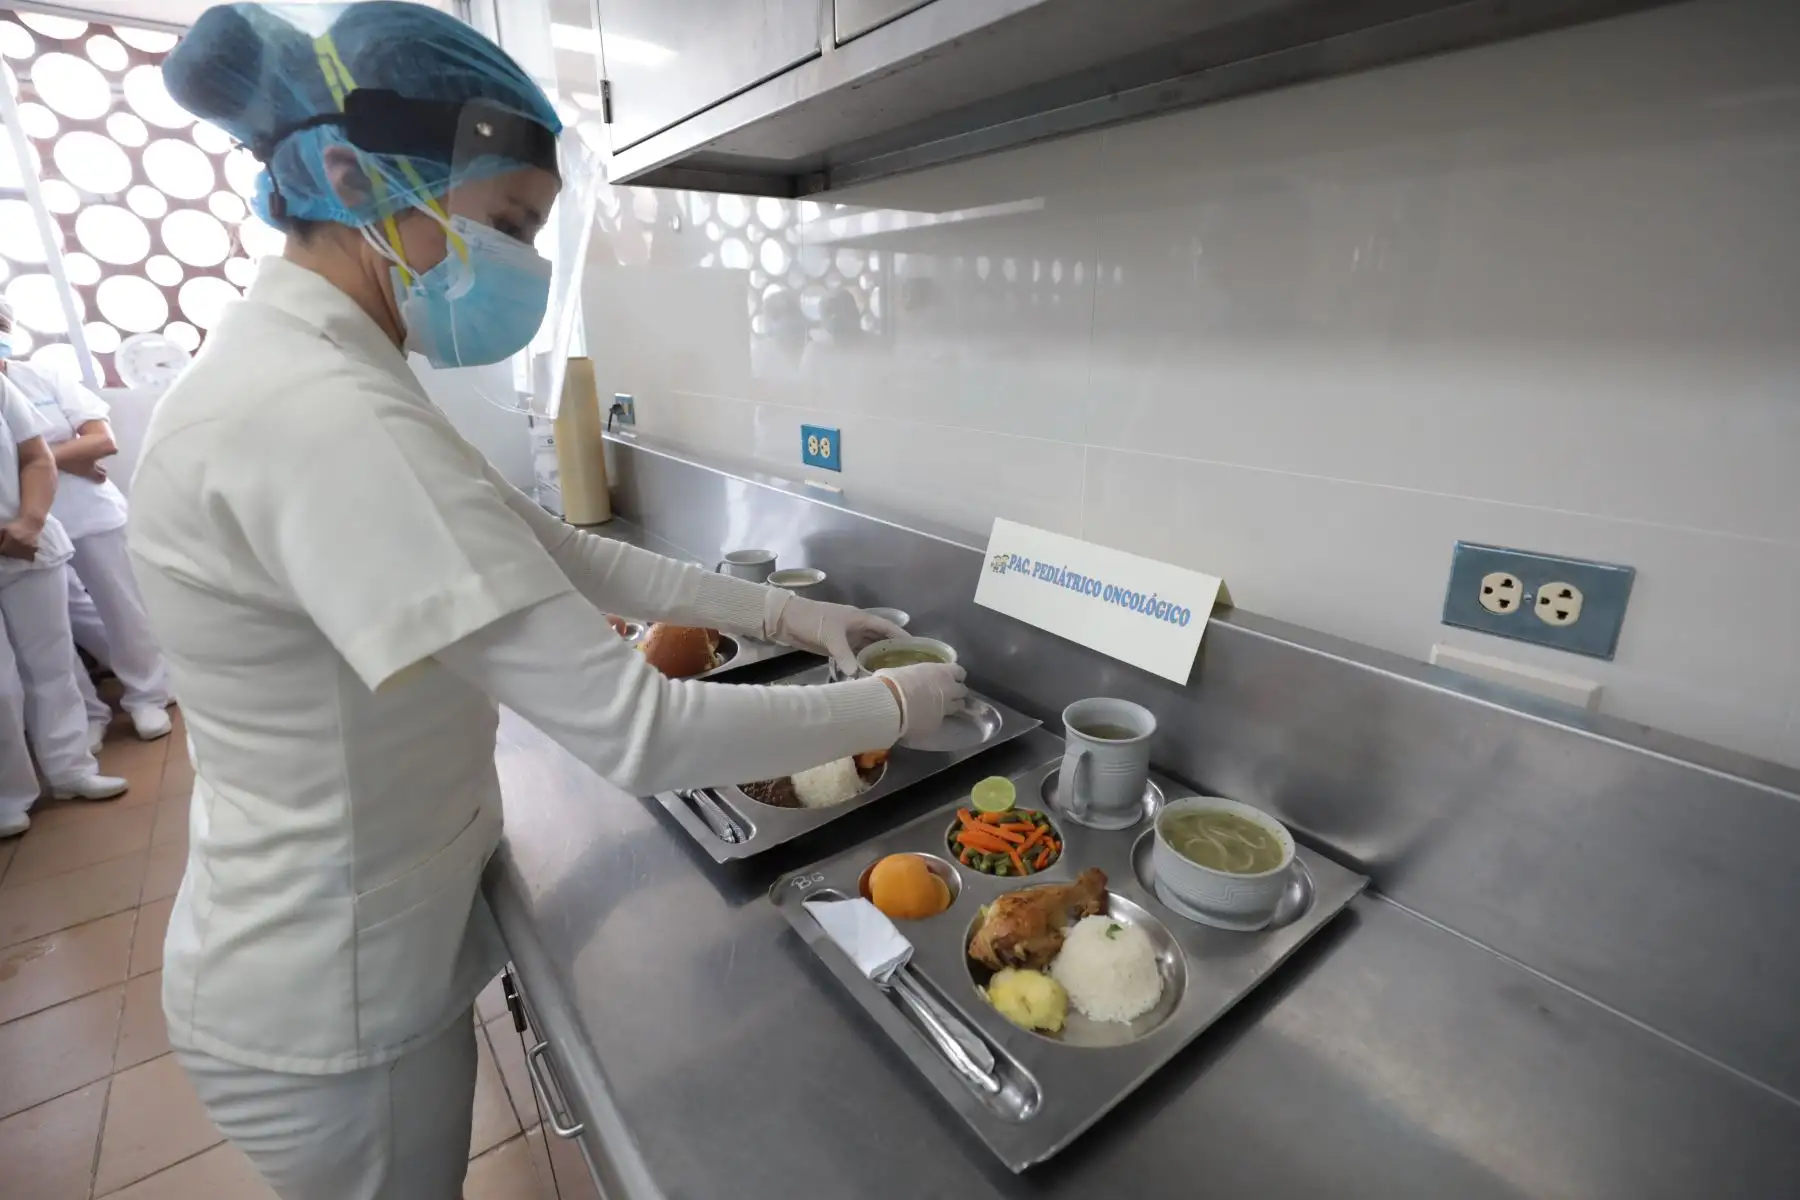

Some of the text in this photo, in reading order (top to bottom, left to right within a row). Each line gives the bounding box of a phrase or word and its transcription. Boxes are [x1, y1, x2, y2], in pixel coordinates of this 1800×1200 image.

[1008, 553, 1190, 627] PAC. PEDIÁTRICO ONCOLÓGICO
